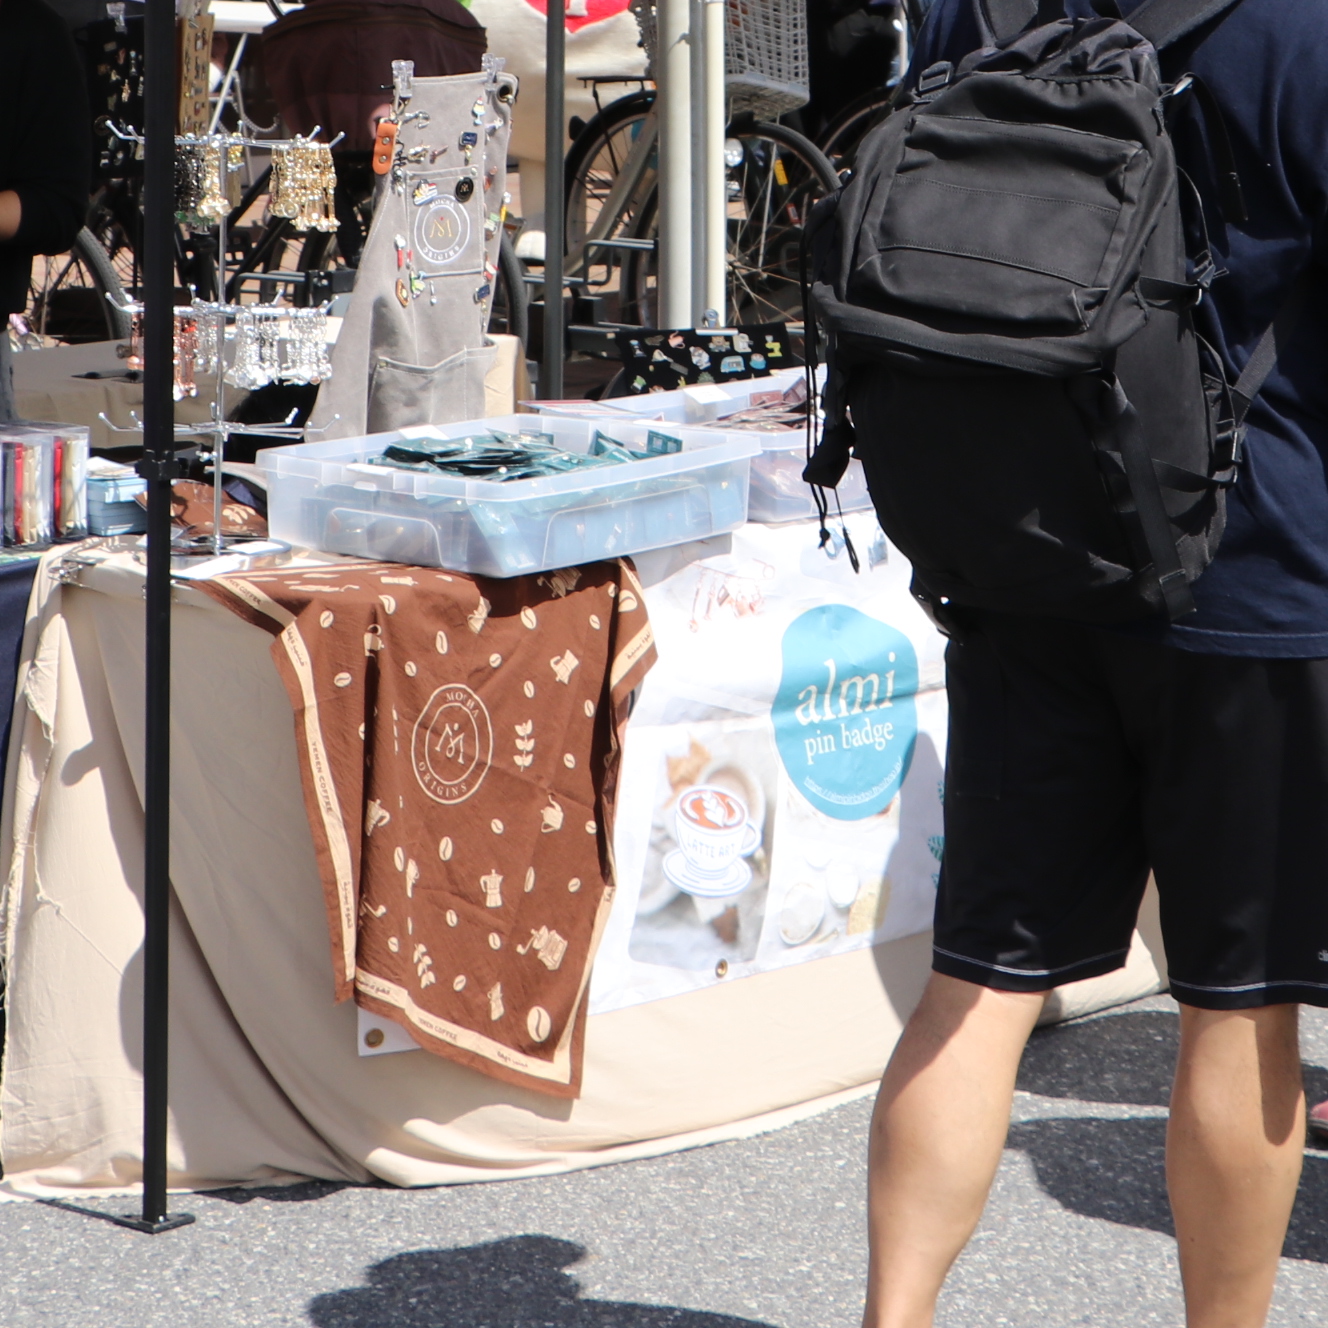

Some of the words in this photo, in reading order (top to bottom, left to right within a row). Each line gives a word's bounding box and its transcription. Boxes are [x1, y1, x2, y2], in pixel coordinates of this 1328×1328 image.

[795, 651, 895, 726] almi
[804, 729, 836, 765] pin
[840, 717, 894, 751] badge
[419, 761, 467, 797] ORIGINS
[687, 834, 715, 859] LATTE
